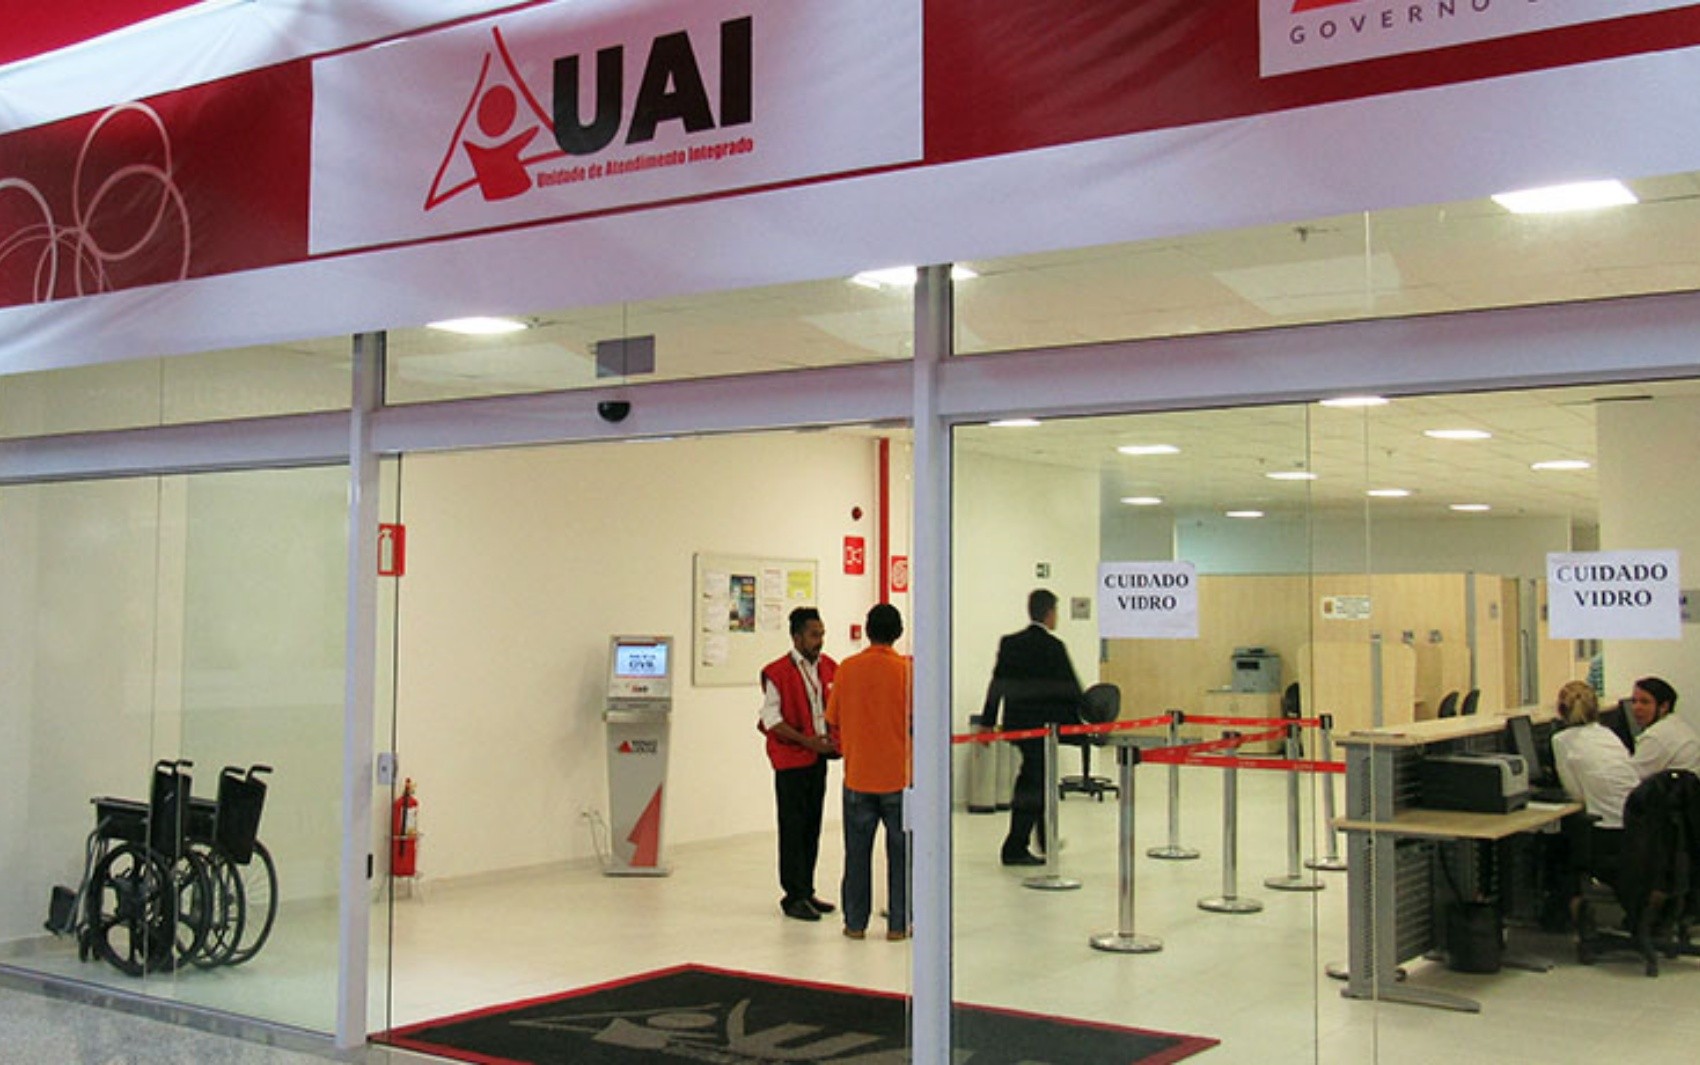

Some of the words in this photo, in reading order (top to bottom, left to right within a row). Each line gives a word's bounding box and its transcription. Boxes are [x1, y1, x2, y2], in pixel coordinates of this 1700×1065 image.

[1289, 0, 1490, 44] GOVERNO
[553, 15, 753, 155] UAI
[537, 166, 586, 188] Unidade
[588, 163, 603, 180] de
[606, 149, 686, 175] Atendimento
[688, 137, 754, 162] Integrado
[1103, 573, 1189, 588] CUIDADO
[1557, 563, 1668, 582] CUIDADO
[1117, 595, 1177, 610] VIDRO
[1574, 589, 1652, 606] VIDRO
